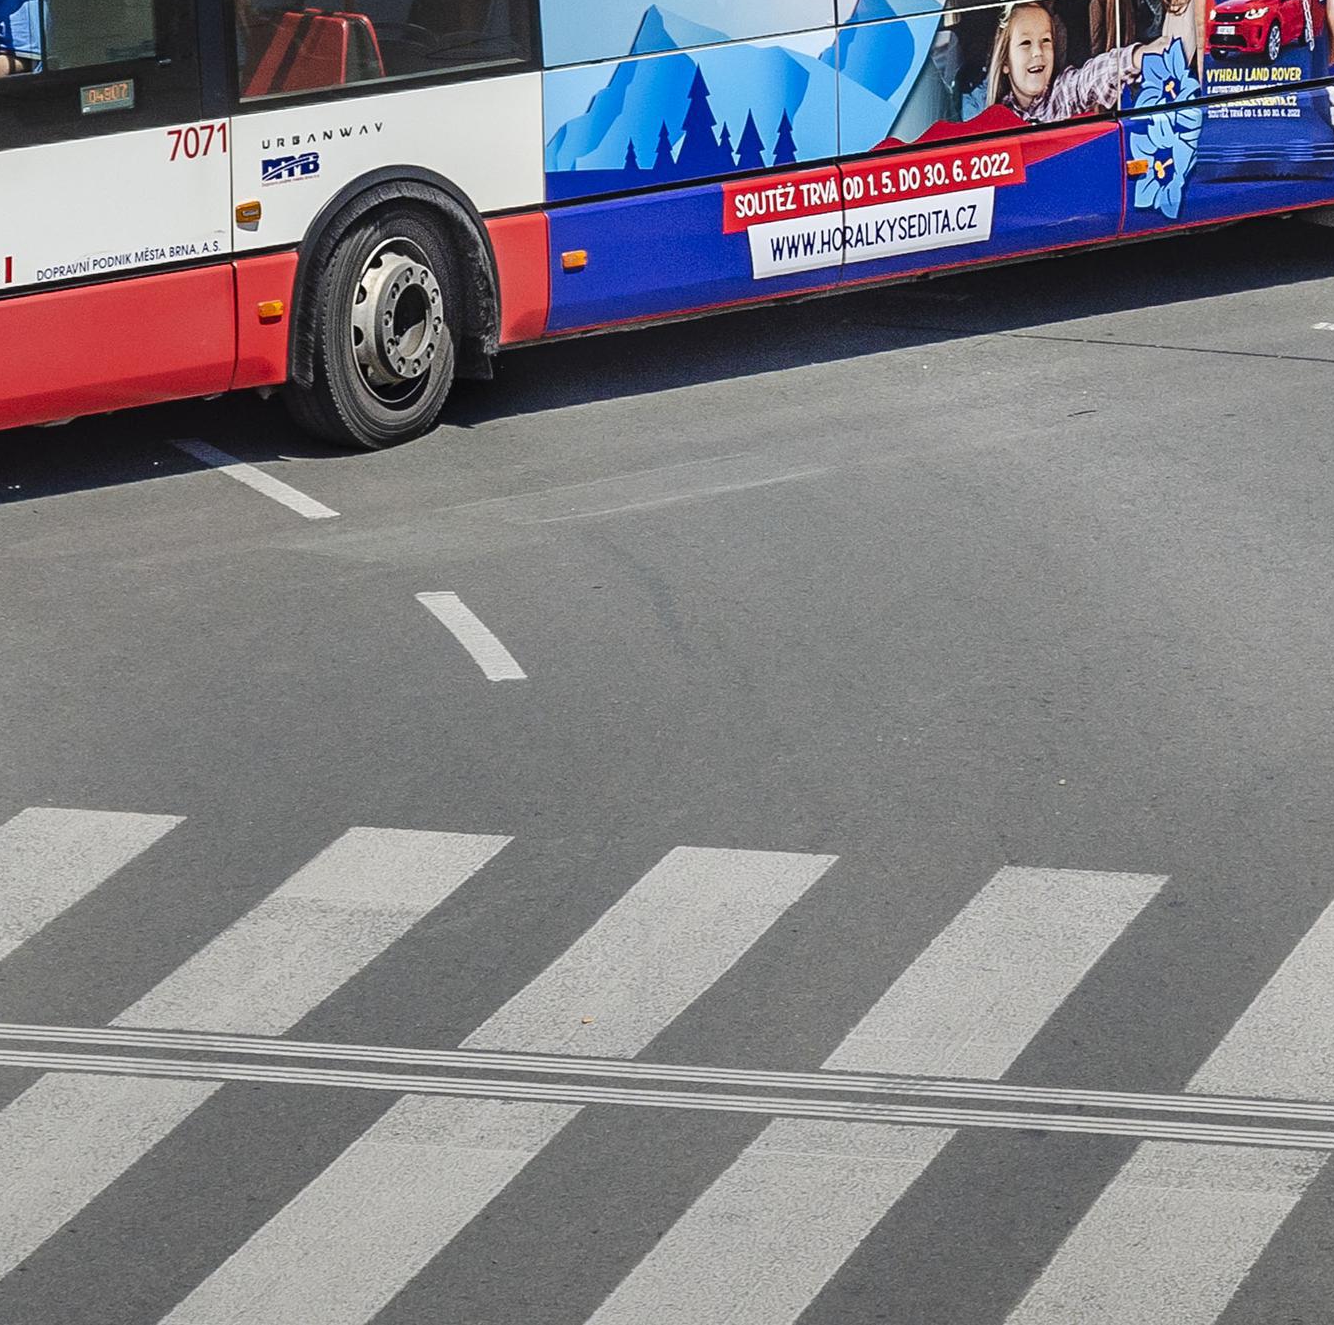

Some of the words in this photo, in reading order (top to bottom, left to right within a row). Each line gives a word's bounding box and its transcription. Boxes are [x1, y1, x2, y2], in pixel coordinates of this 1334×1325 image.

[1206, 67, 1242, 82] VYHRAJ
[1244, 67, 1269, 81] LAND
[1271, 67, 1302, 80] ROVER
[167, 122, 227, 161] 7071
[735, 185, 796, 219] SOUTĚŽ
[802, 177, 839, 206] TRVÁ
[842, 177, 863, 199] OD
[867, 174, 878, 195] 1.
[880, 172, 896, 194] 5.
[899, 167, 921, 190] DO
[924, 163, 949, 187] 30.
[952, 159, 967, 182] 6.
[971, 152, 1014, 179] 2022.
[770, 205, 977, 262] WWW.HORALKYSEDITA.CZ
[36, 260, 90, 282] DOPRAVNÍ
[92, 253, 131, 271] PODNIK
[135, 247, 166, 265] MĚSTA
[169, 243, 198, 259] BRNA,
